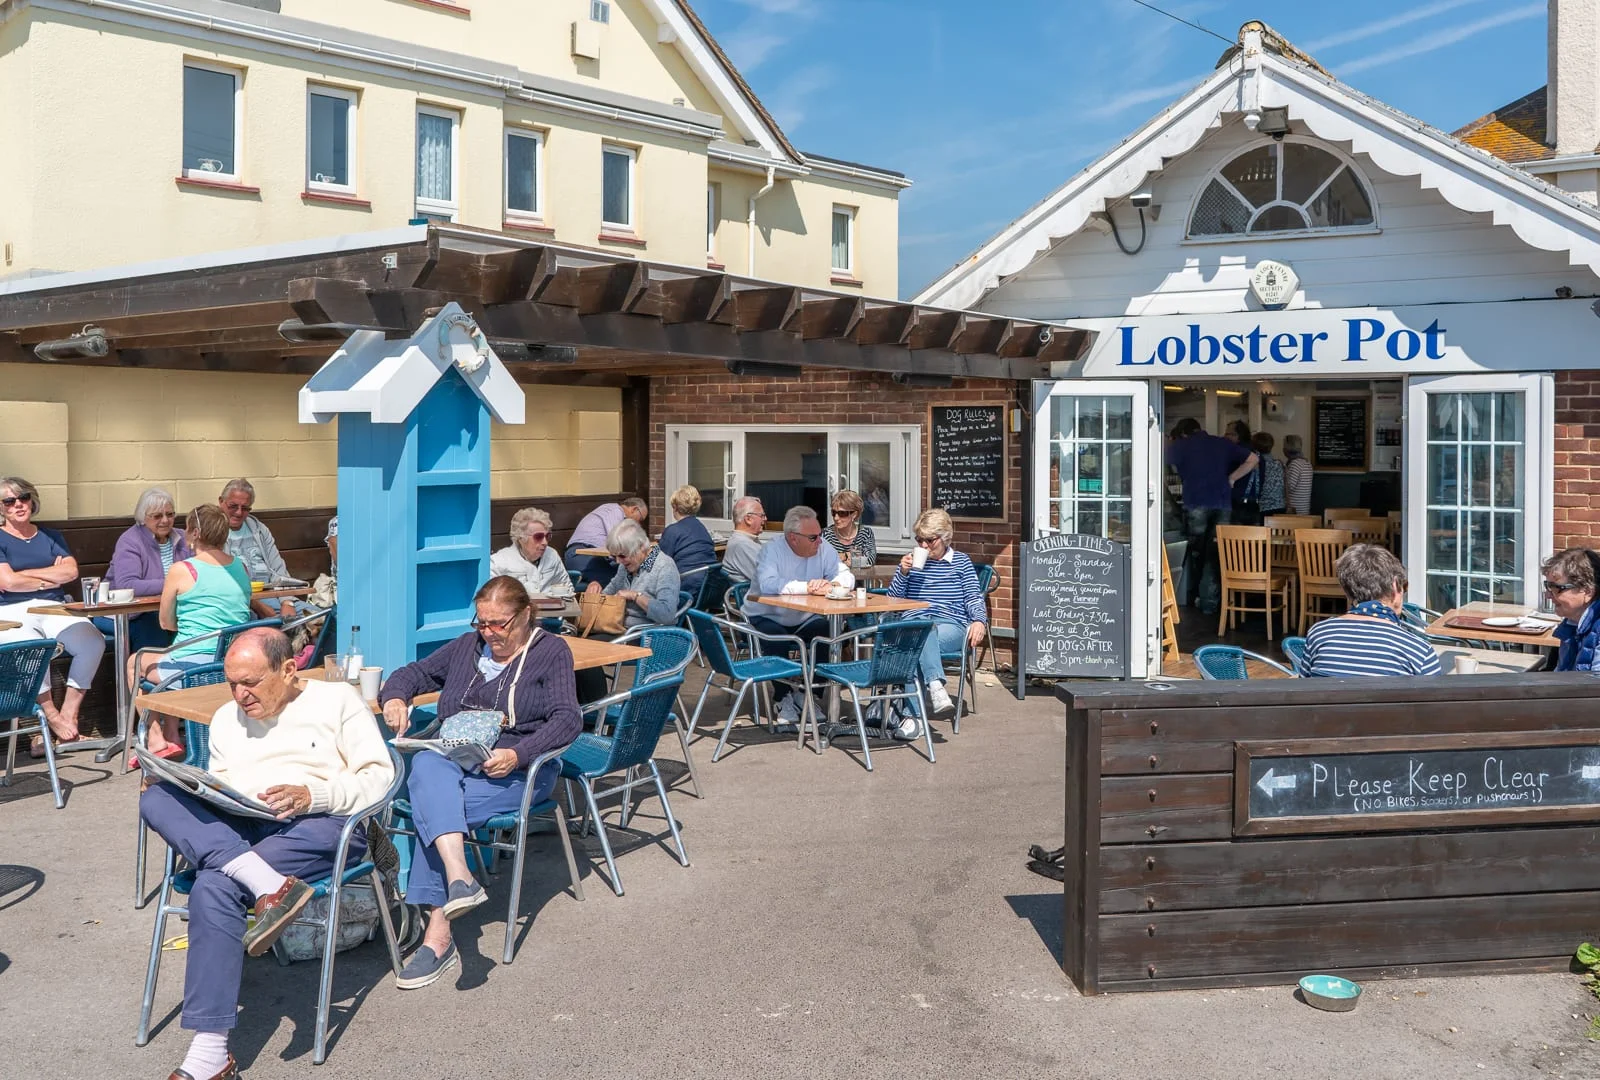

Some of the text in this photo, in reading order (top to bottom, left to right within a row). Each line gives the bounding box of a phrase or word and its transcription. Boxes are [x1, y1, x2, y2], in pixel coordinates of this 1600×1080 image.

[1116, 318, 1447, 366] Lobster Pot
[1031, 552, 1067, 572] Monday
[1074, 554, 1114, 575] Sunday
[1033, 607, 1052, 618] Last
[1031, 623, 1044, 633] We
[1068, 626, 1078, 634] at
[1037, 640, 1113, 652] NO DOGS AFTER
[1312, 756, 1549, 799] Please Keep Clear
